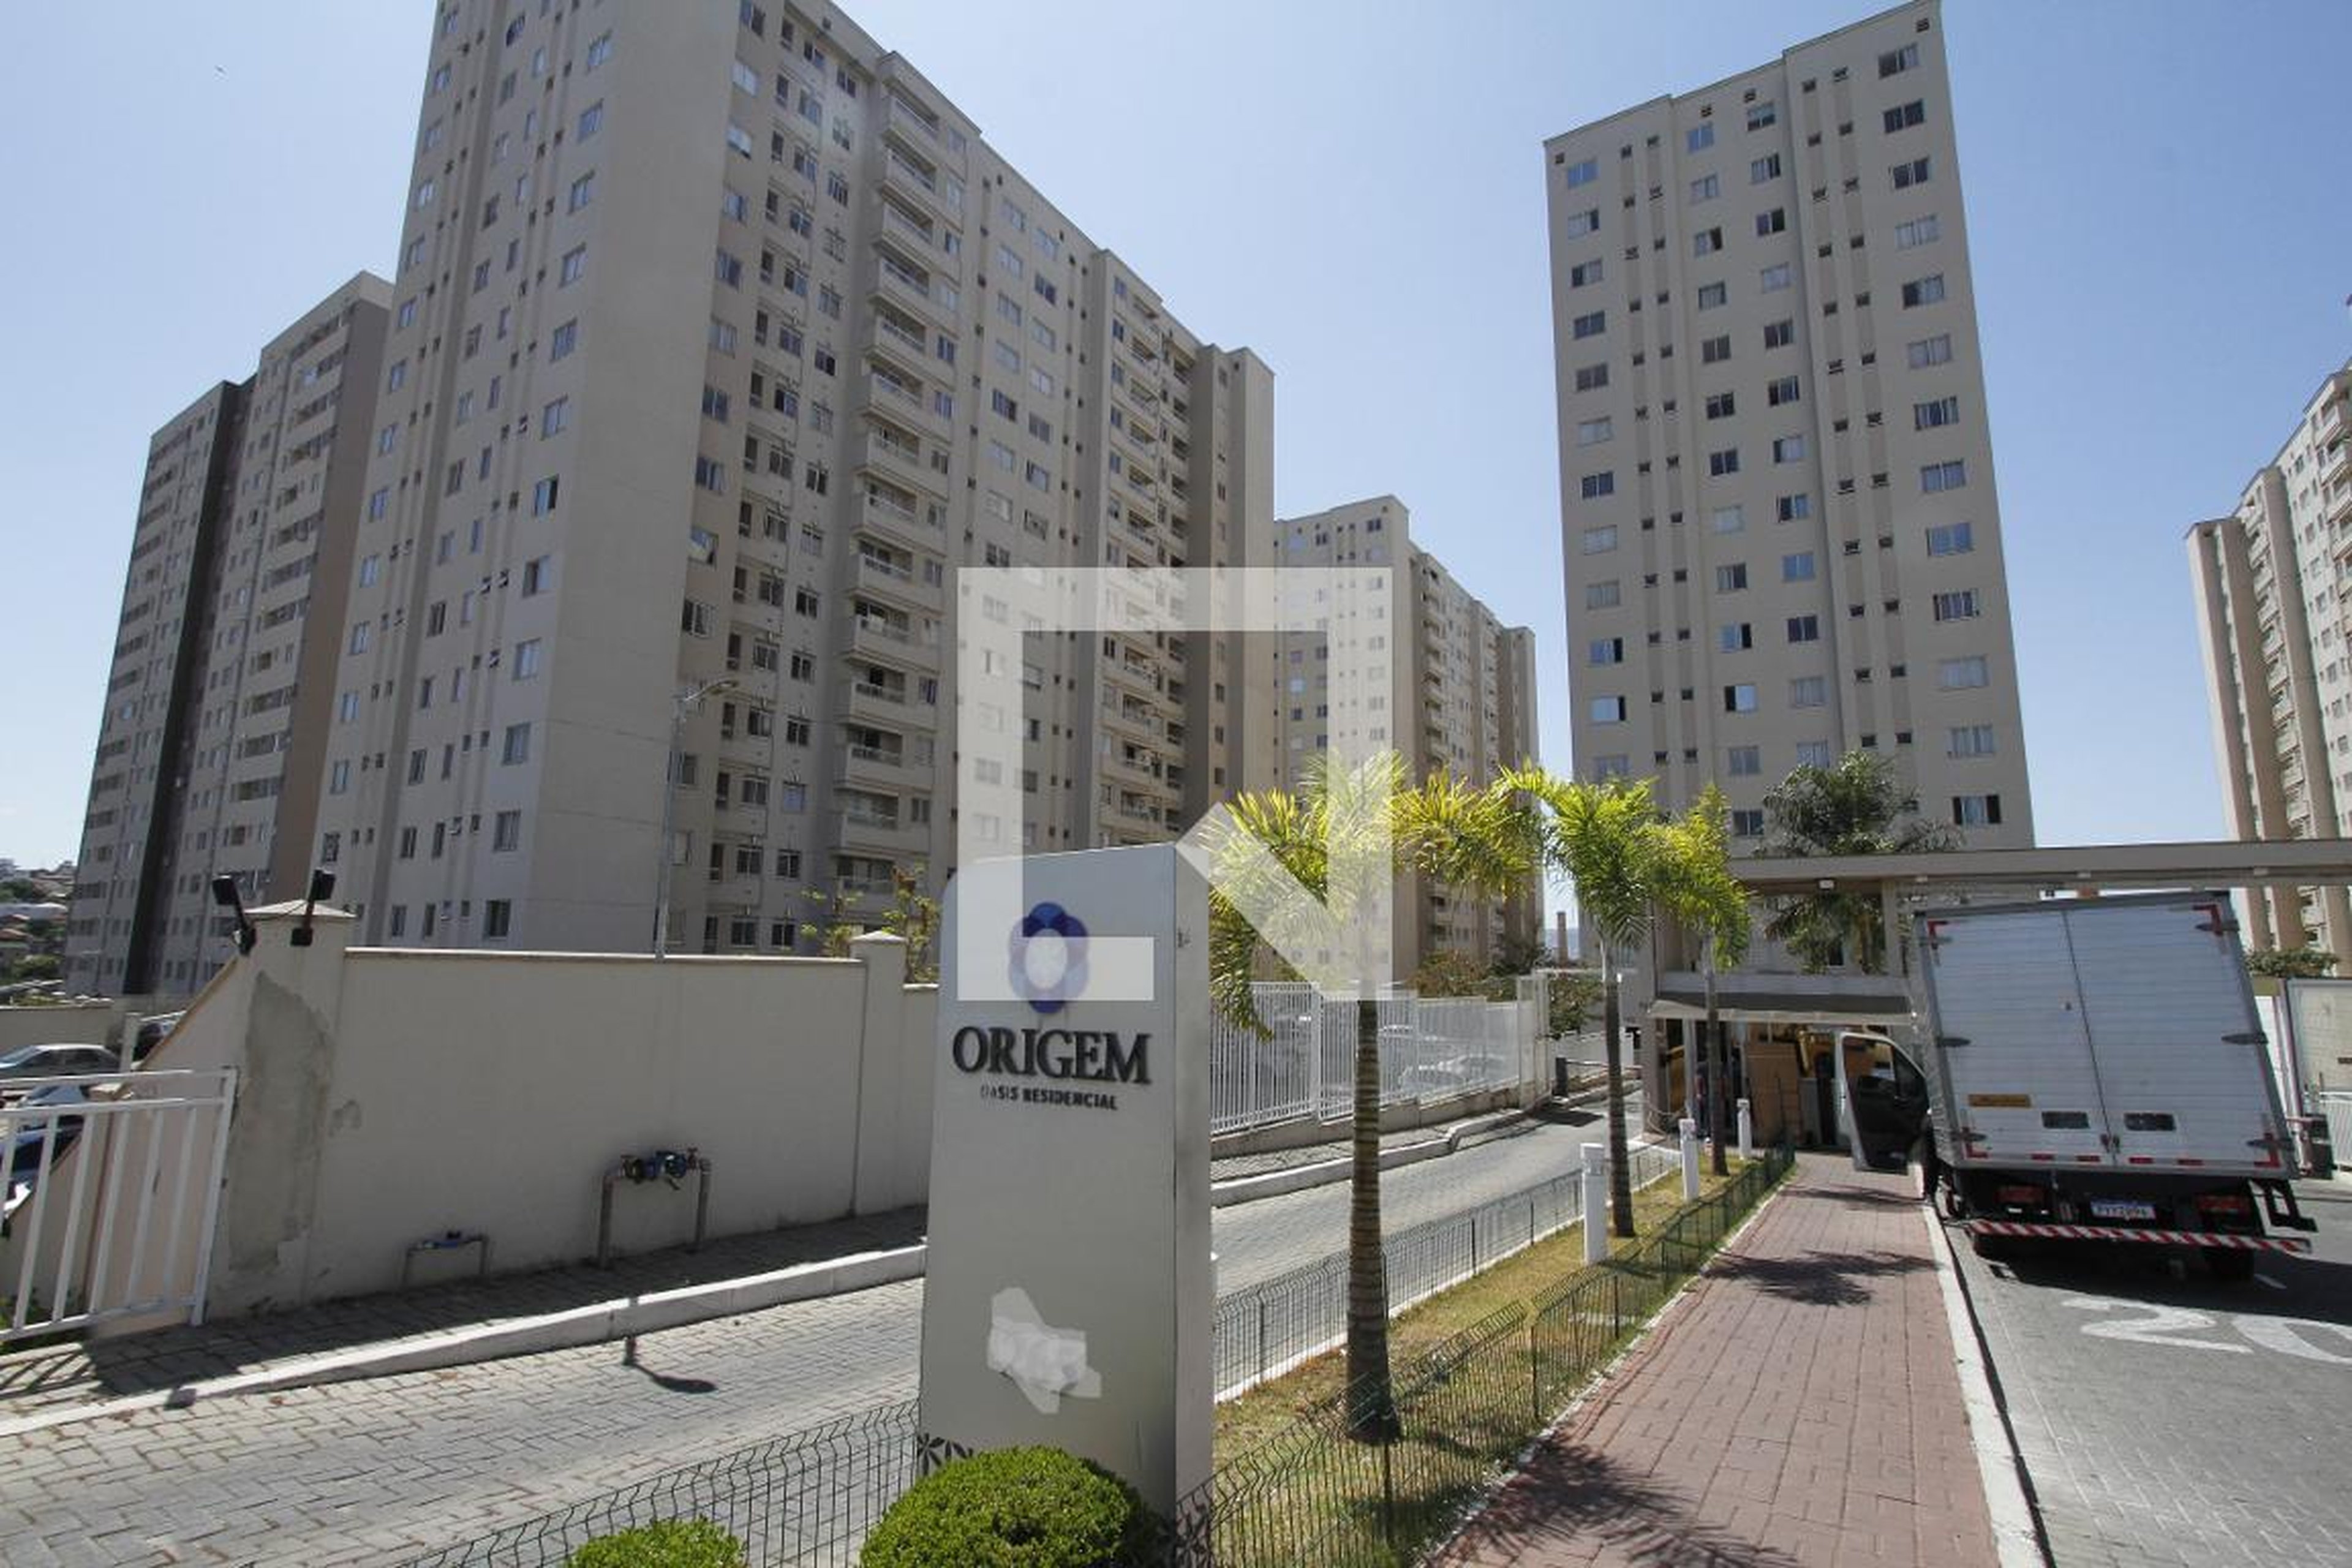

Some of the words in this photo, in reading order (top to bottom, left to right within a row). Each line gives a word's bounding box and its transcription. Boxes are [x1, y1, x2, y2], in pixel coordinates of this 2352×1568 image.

[952, 1025, 1152, 1085] ORIGEM
[980, 1085, 1019, 1101] OASIS
[1022, 1088, 1118, 1110] RESIDENCIAL
